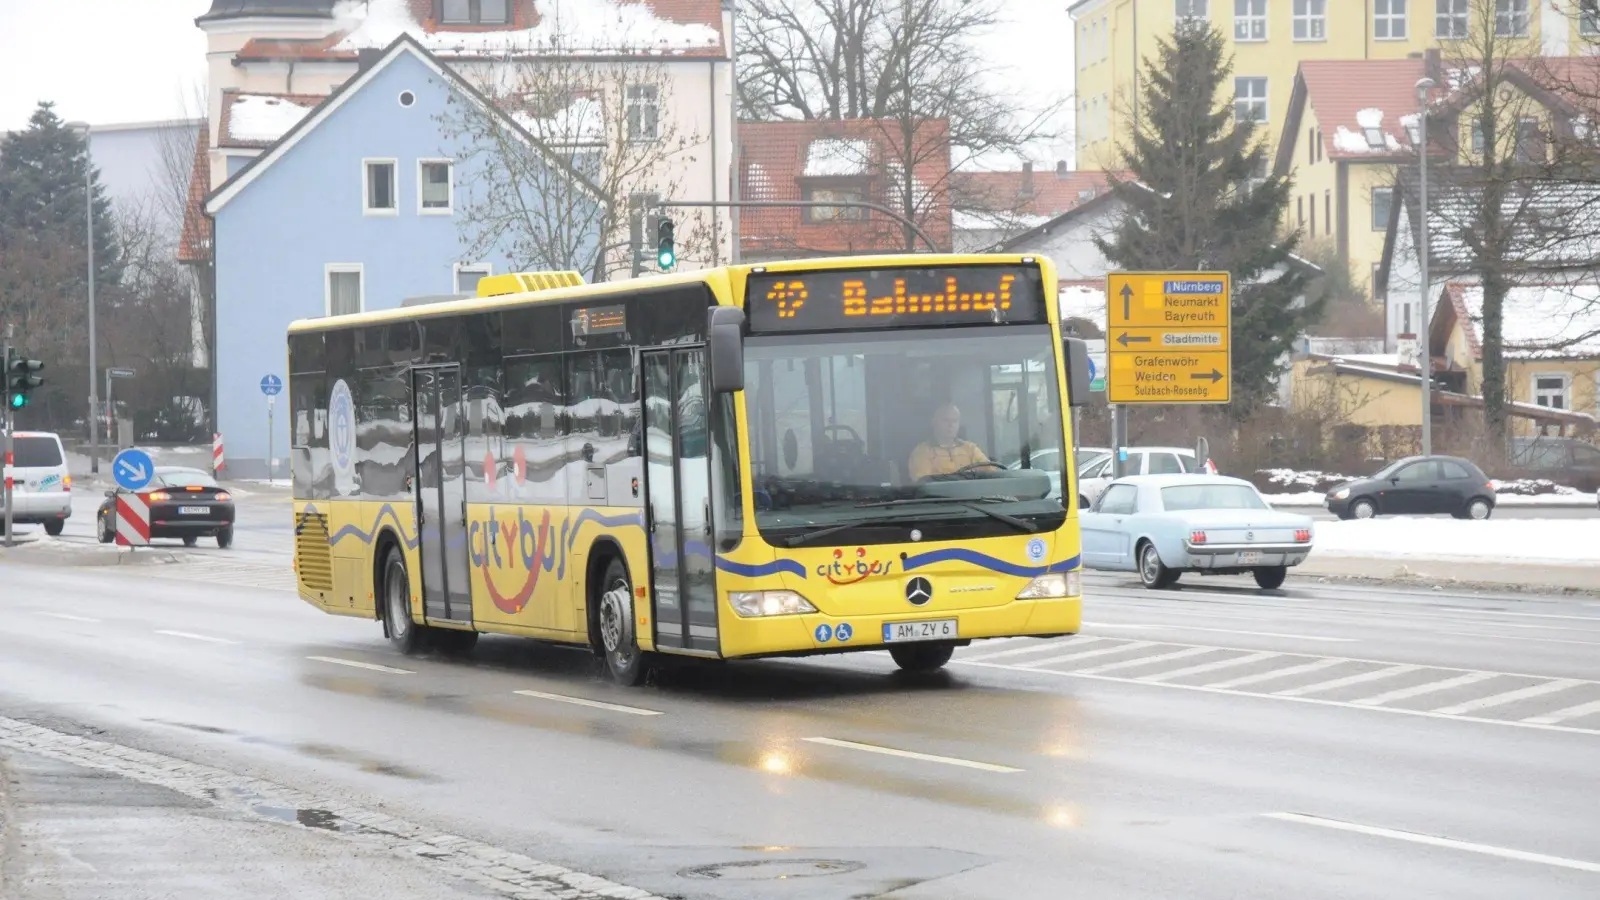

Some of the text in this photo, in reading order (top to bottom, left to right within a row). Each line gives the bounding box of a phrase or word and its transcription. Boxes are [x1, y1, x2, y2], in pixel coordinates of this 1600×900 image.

[1172, 281, 1221, 293] Nürnberg
[842, 275, 1015, 316] Bahnhof
[1164, 297, 1219, 307] Neumarkt
[1164, 311, 1215, 322] Bayreuth
[1164, 334, 1218, 344] Stadtmitte
[1134, 355, 1199, 367] Grafenwöhr
[1135, 371, 1176, 381] Weiden
[1134, 385, 1210, 397] Sulzbach-Rosenbg.
[898, 622, 950, 637] AM ZY 6
